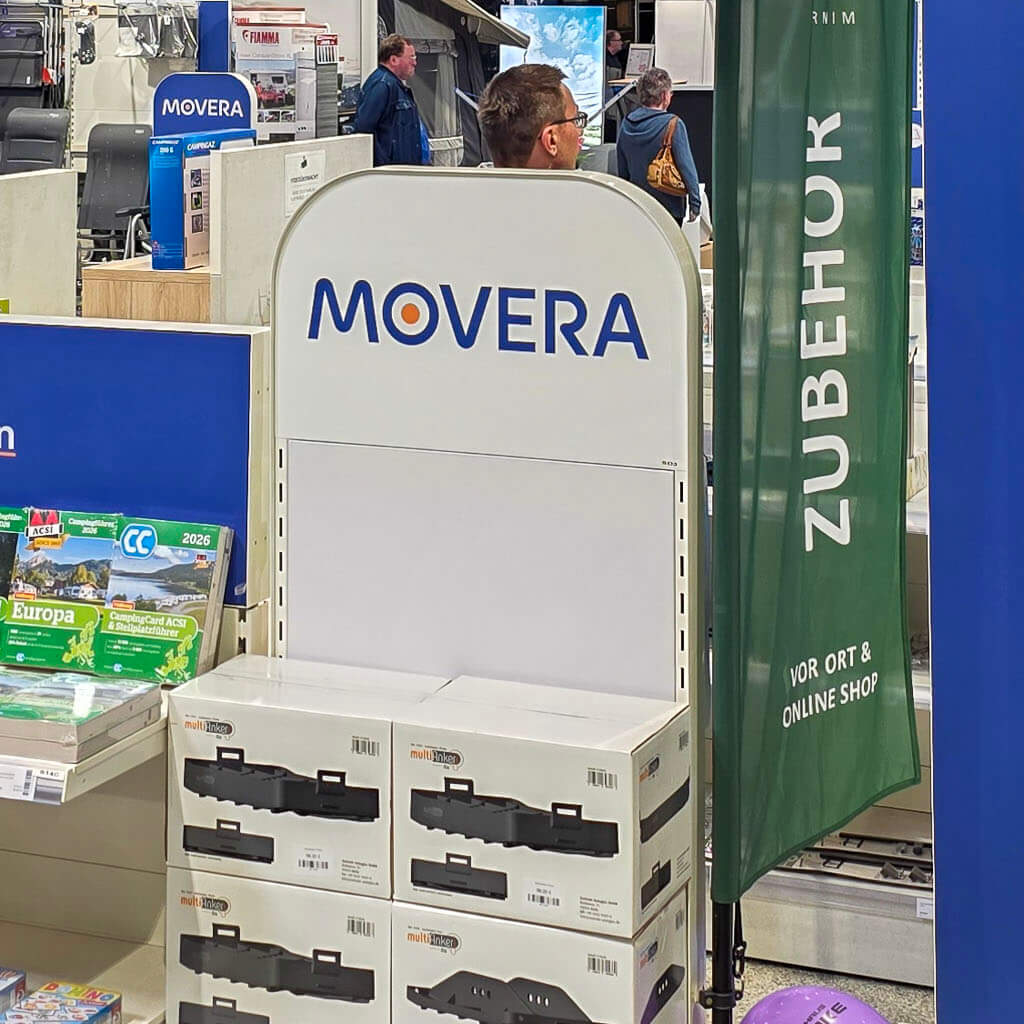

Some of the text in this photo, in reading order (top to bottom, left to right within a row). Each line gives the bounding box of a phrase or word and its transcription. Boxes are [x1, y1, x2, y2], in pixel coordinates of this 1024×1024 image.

[250, 31, 280, 44] FIAMMA
[162, 99, 244, 117] MOVERA
[307, 277, 650, 360] MOVERA
[33, 526, 54, 535] ACSI
[182, 533, 211, 546] 2026
[12, 601, 75, 626] Europa
[110, 612, 187, 628] CampingCard ACSI
[790, 641, 872, 688] VOR ORT &
[782, 672, 878, 728] ONLINE SHOP
